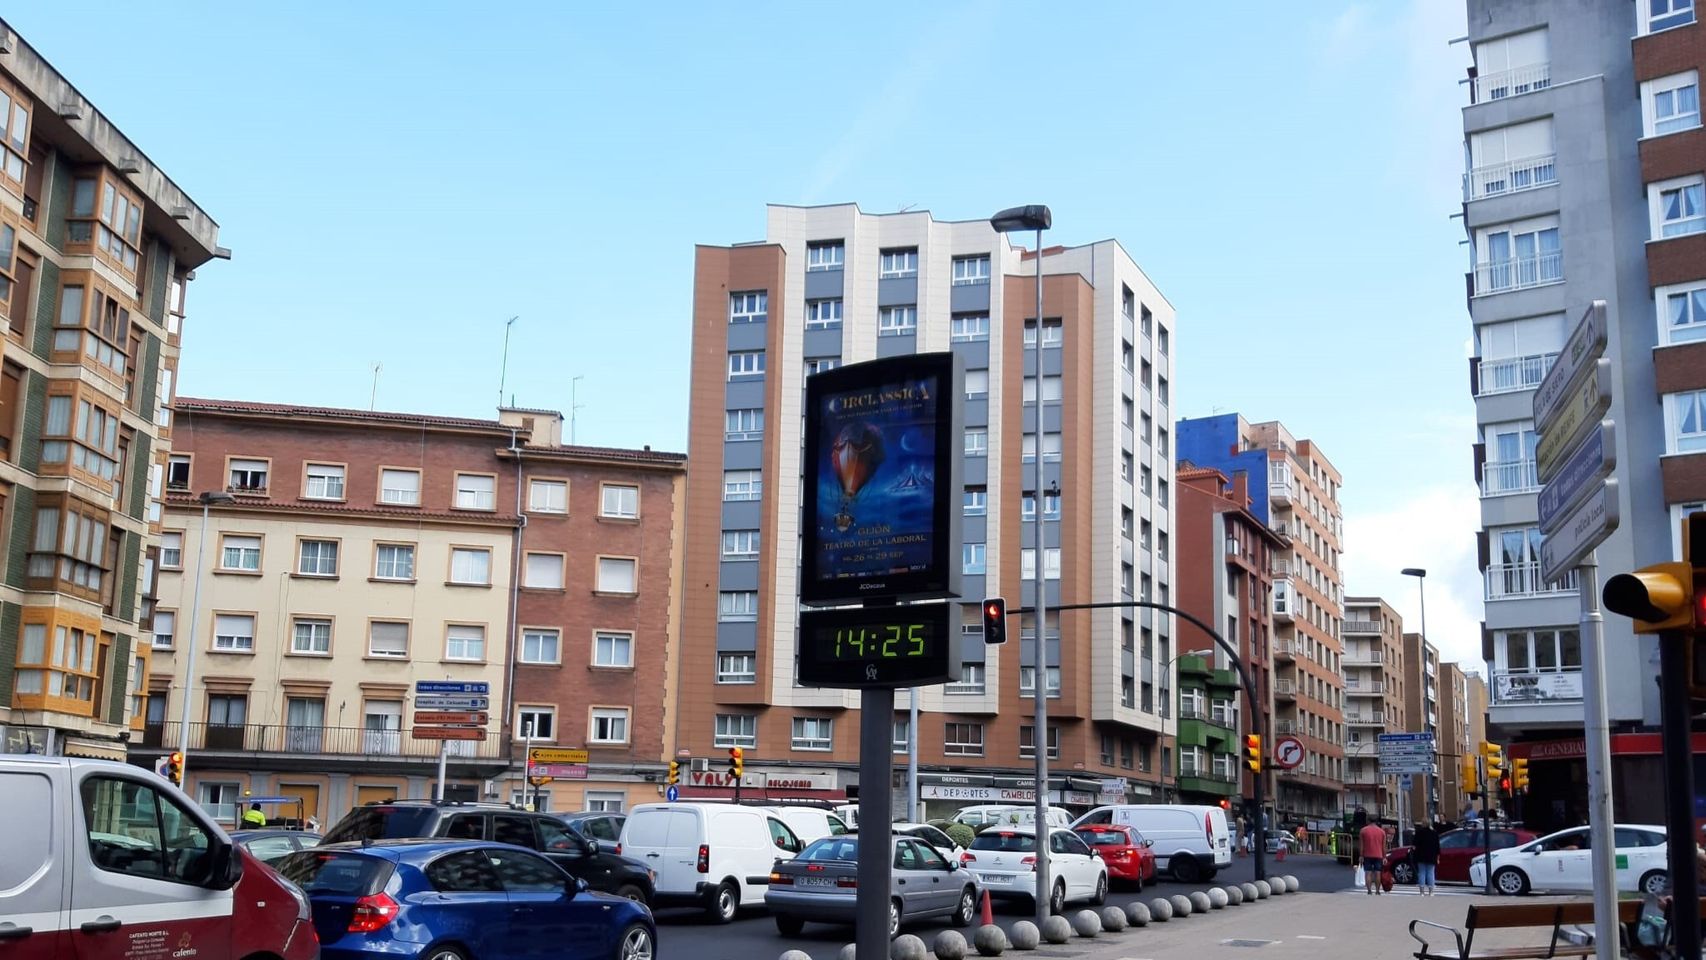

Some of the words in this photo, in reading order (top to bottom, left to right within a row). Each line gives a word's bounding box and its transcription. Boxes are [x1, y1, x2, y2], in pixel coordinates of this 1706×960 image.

[824, 540, 856, 551] TEATRO
[858, 540, 870, 548] DE
[872, 538, 883, 546] LA
[885, 534, 927, 545] LABORAL
[835, 625, 925, 658] 14:25
[1544, 741, 1586, 755] GENERAL
[692, 773, 734, 786] VALY
[942, 776, 969, 784] DEPORTES
[172, 948, 197, 958] cafento
